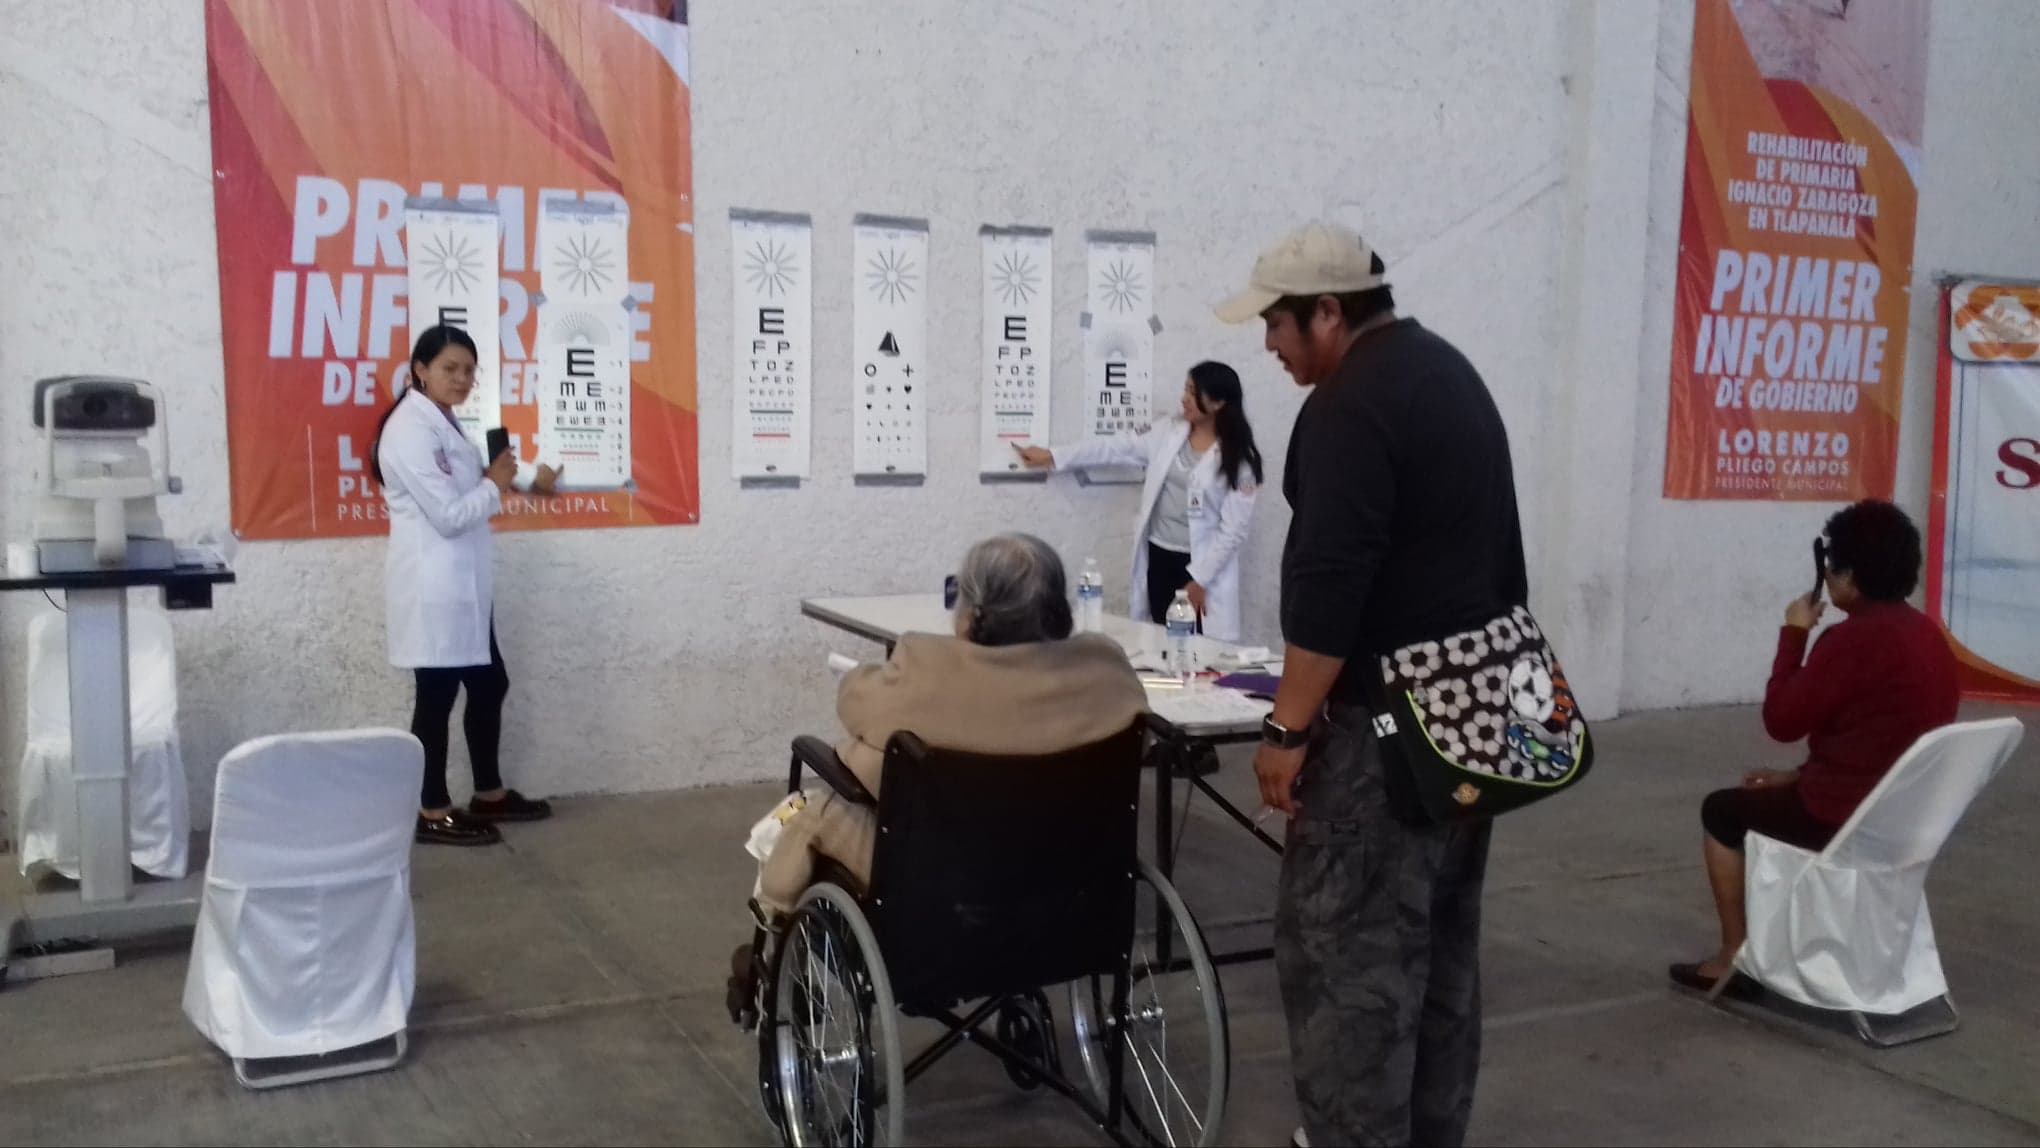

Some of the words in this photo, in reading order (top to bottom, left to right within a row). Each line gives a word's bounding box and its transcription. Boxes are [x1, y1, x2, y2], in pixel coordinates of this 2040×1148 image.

[1747, 131, 1868, 167] REHABILITACIÓN
[1756, 158, 1775, 181] DE
[1780, 160, 1856, 190] PRIMARIA
[1728, 180, 1792, 207] IGNACIO
[1798, 188, 1878, 218] ZARAGOZA
[1748, 207, 1768, 230] EN
[1710, 250, 1881, 321] PRIMER
[759, 308, 784, 335] E
[1004, 316, 1026, 341] E
[567, 348, 595, 376] E
[1694, 315, 1888, 383] INFORME
[322, 361, 378, 406] DE
[1105, 362, 1127, 388] E
[1715, 377, 1747, 410] DE
[1750, 380, 1858, 413] GOBIERNO
[1718, 428, 1849, 457] LORENZO
[1716, 456, 1776, 474] PLIEGO
[1782, 459, 1849, 476] CAMPOS
